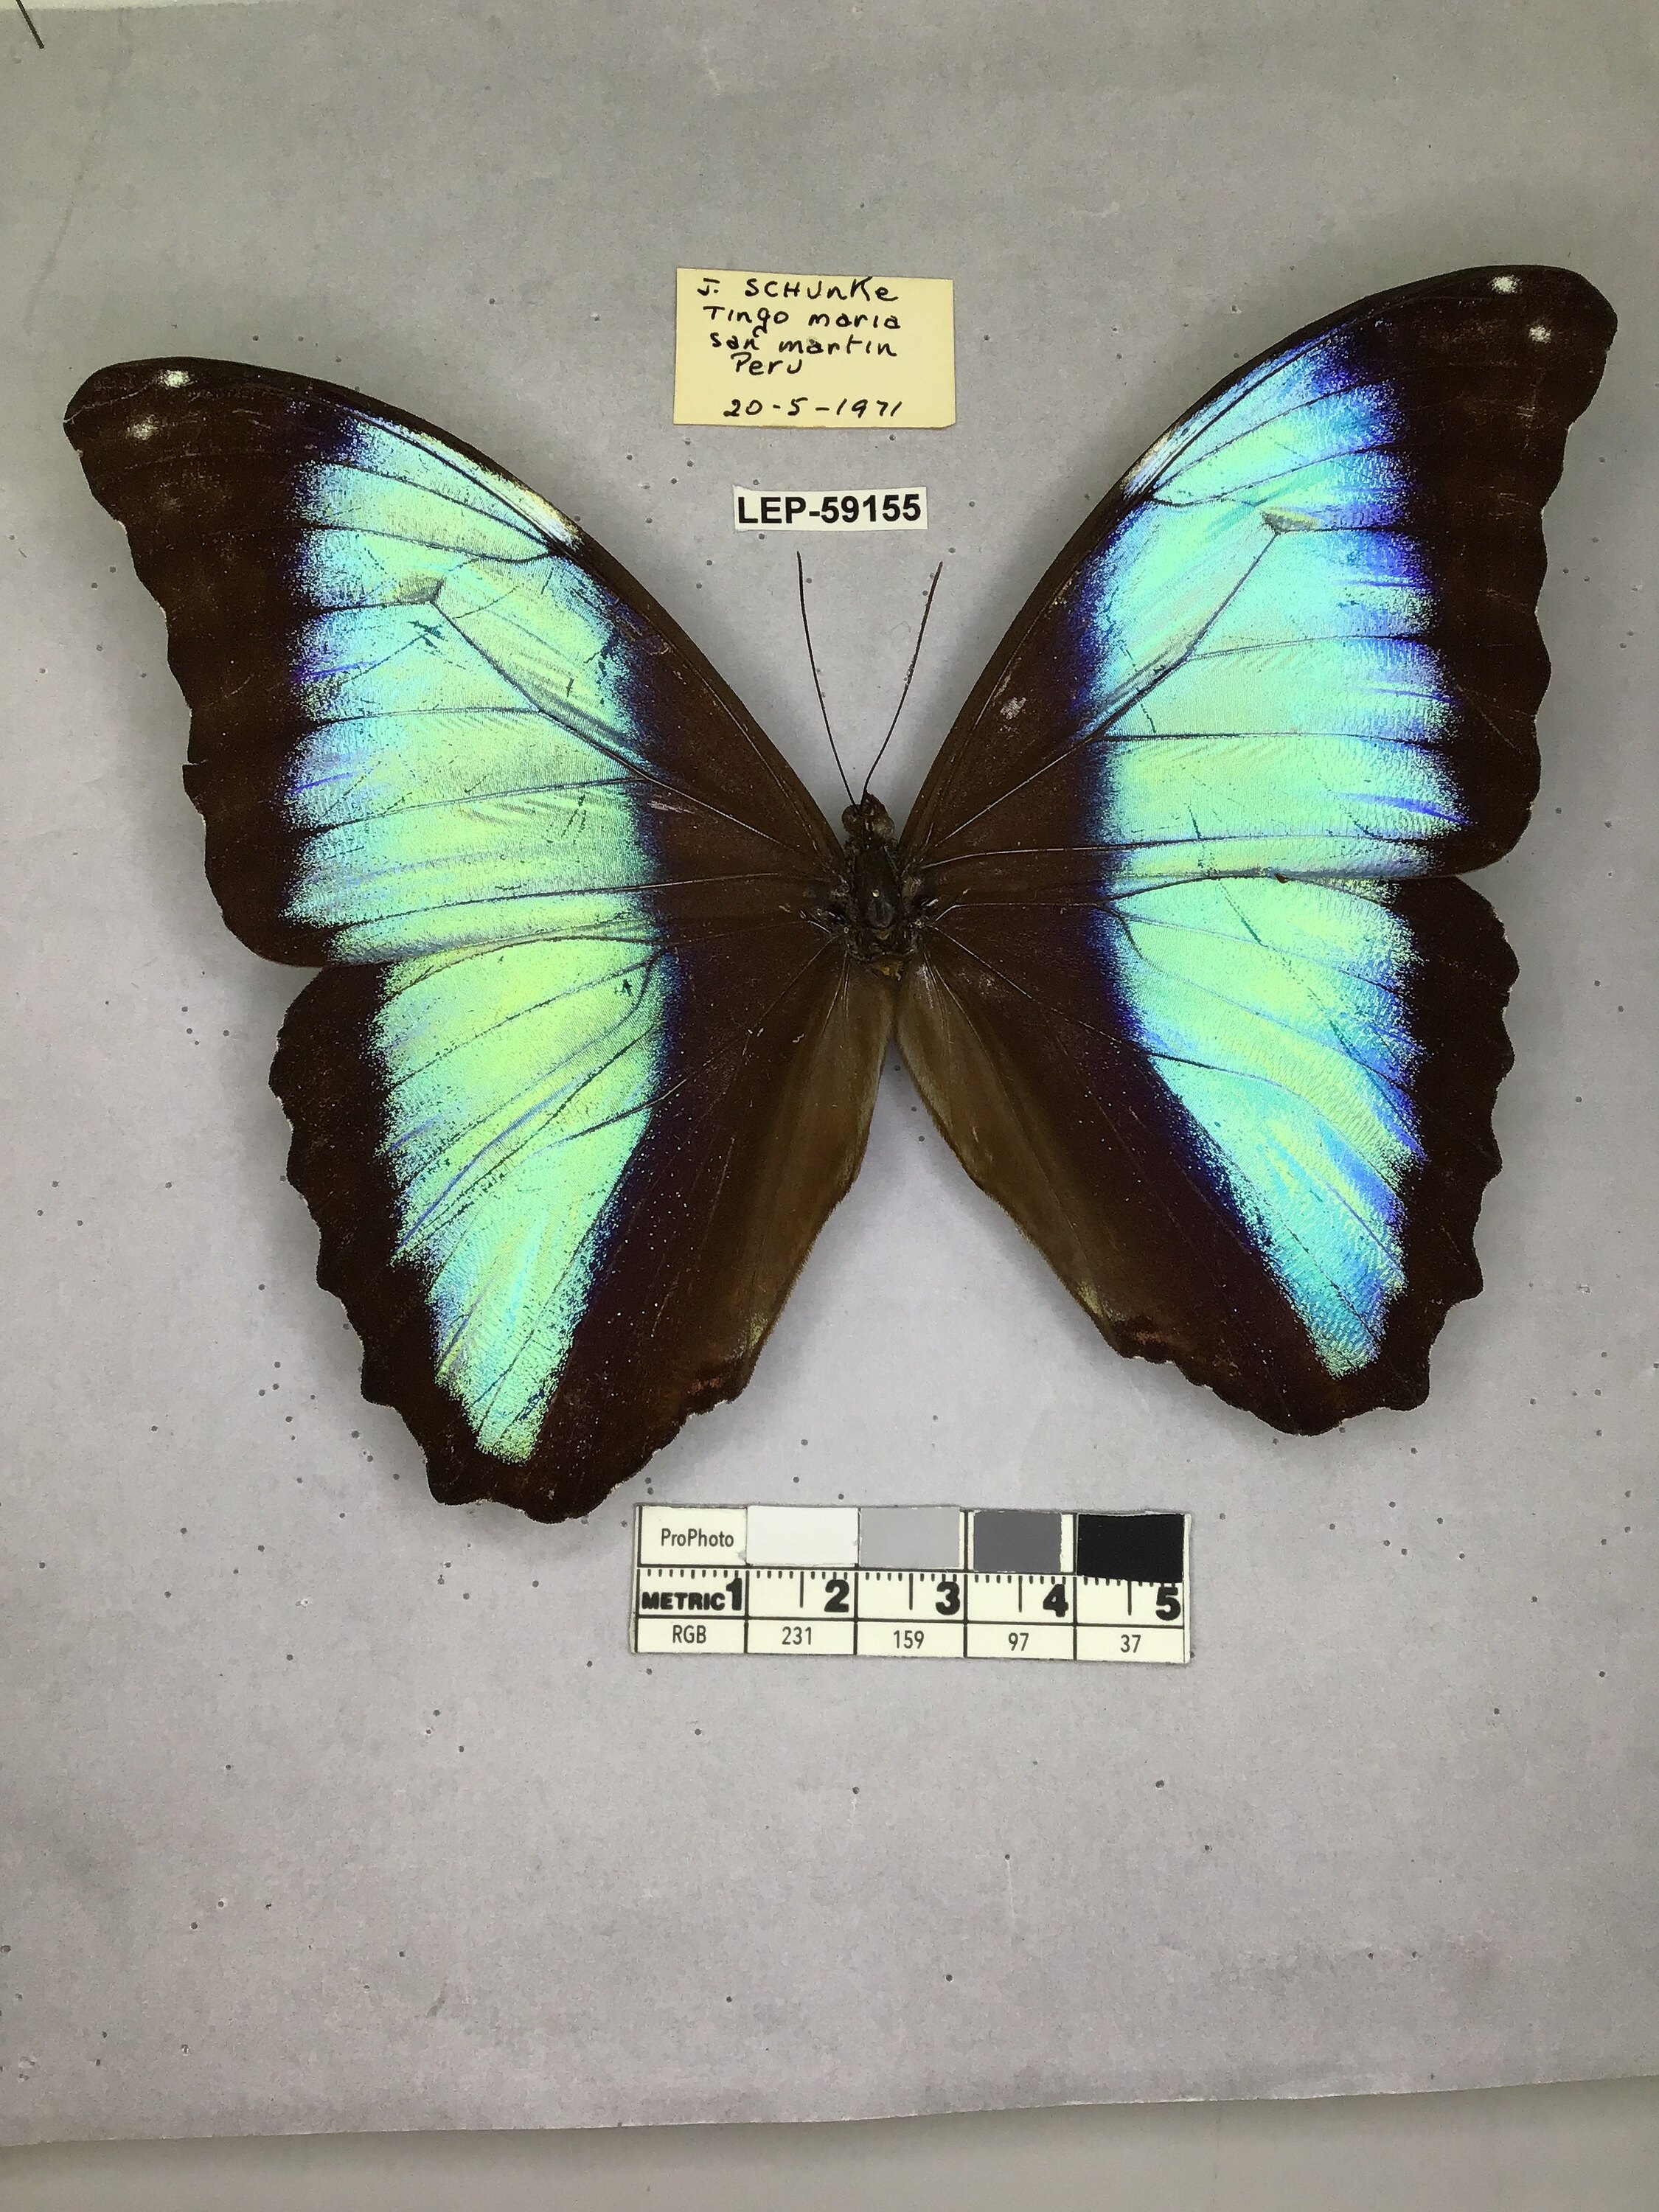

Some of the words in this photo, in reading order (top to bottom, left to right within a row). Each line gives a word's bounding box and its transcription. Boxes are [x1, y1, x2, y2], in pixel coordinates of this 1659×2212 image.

[697, 277, 720, 296] J.
[778, 334, 897, 357] martin
[730, 352, 803, 376] Peru
[737, 493, 922, 524] LEP-59155
[661, 1528, 734, 1547] ProPhoto
[641, 1591, 726, 1610] METRIC
[726, 1577, 742, 1611] 1
[824, 1579, 850, 1613] 2
[935, 1581, 960, 1615] 3
[1043, 1583, 1069, 1618] 4
[1155, 1586, 1181, 1621] 5
[672, 1624, 707, 1644] RGB
[782, 1627, 812, 1646] 231
[893, 1630, 925, 1649] 159
[1008, 1632, 1029, 1652] 97
[1120, 1634, 1141, 1653] 37
